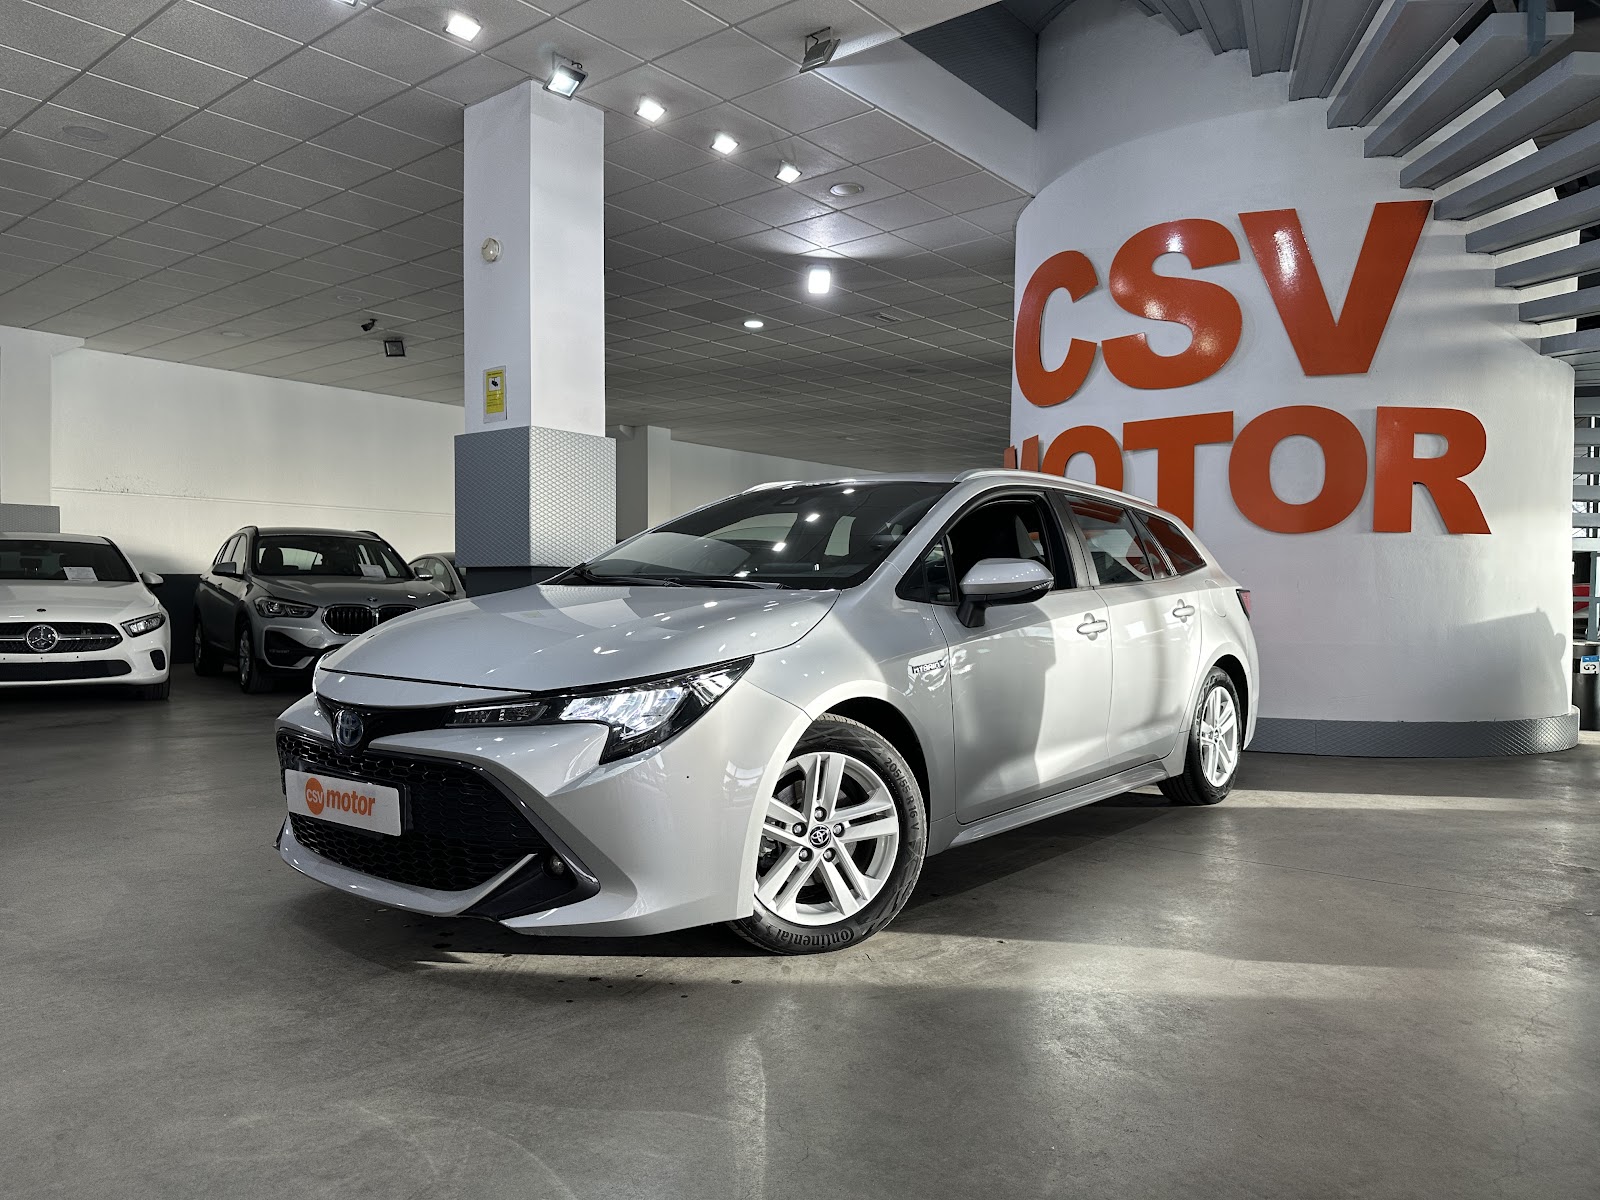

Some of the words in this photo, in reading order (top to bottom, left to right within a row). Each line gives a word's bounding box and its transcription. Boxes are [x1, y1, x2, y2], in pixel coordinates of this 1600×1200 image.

[1014, 200, 1433, 407] CSV
[1004, 405, 1491, 535] TOR
[884, 757, 911, 793] 205/55
[326, 789, 376, 816] motor
[774, 926, 854, 948] Continental
